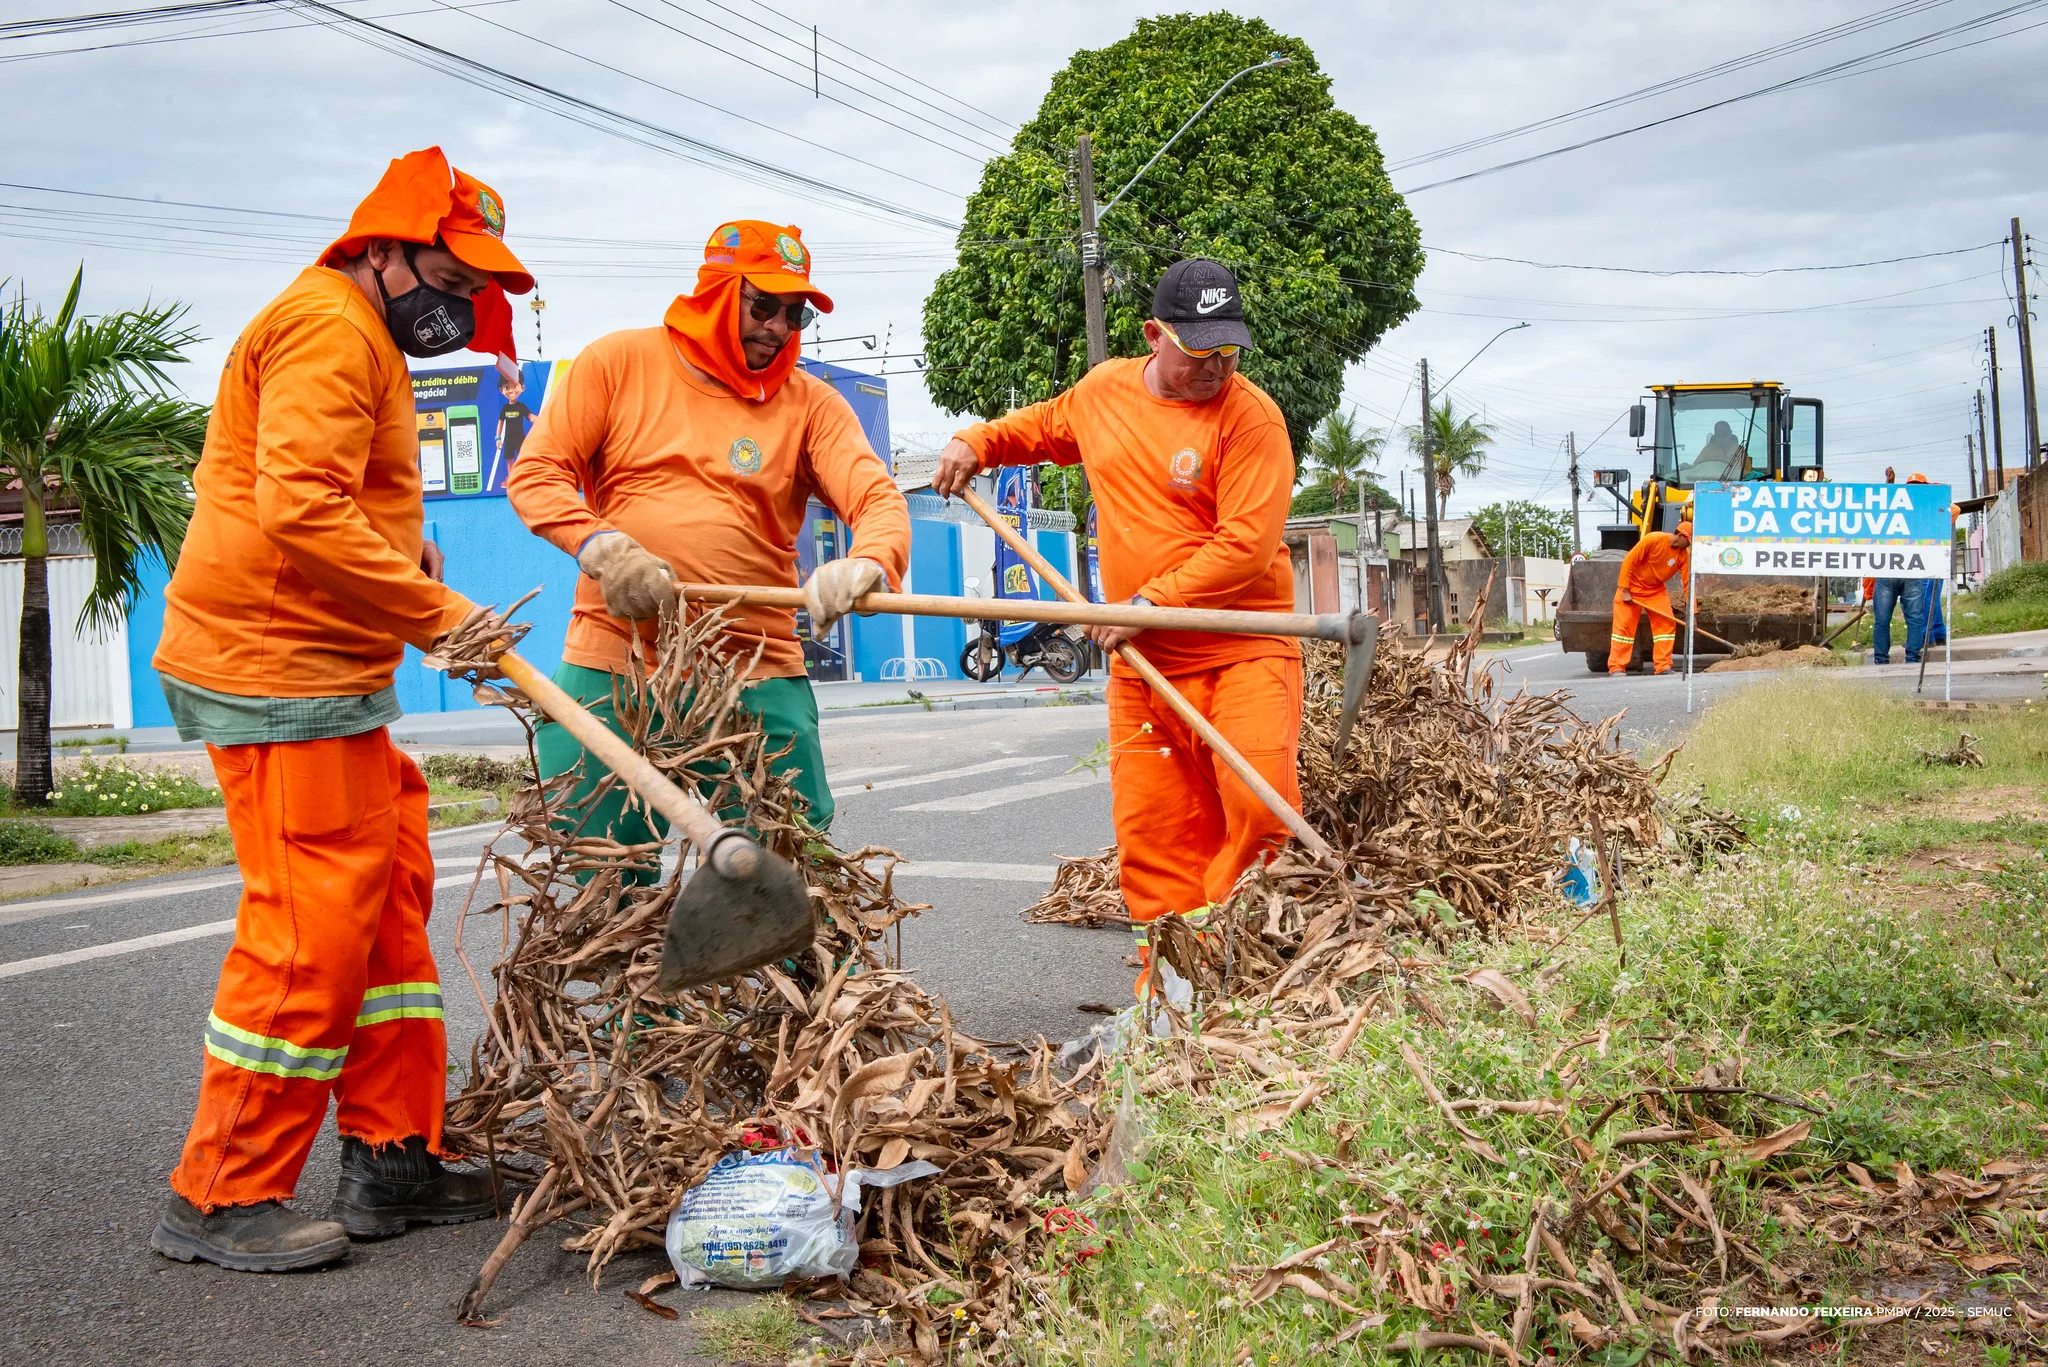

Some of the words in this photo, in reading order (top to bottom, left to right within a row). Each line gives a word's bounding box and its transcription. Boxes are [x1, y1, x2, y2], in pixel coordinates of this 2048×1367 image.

[1200, 288, 1226, 304] NIKE
[422, 377, 447, 387] crédito
[454, 375, 478, 384] débito
[413, 387, 447, 400] negócio!
[1731, 486, 1914, 510] PATRULHA
[1733, 511, 1780, 533] DA
[1790, 511, 1911, 536] CHUVA
[1755, 550, 1926, 571] PREFEITURA
